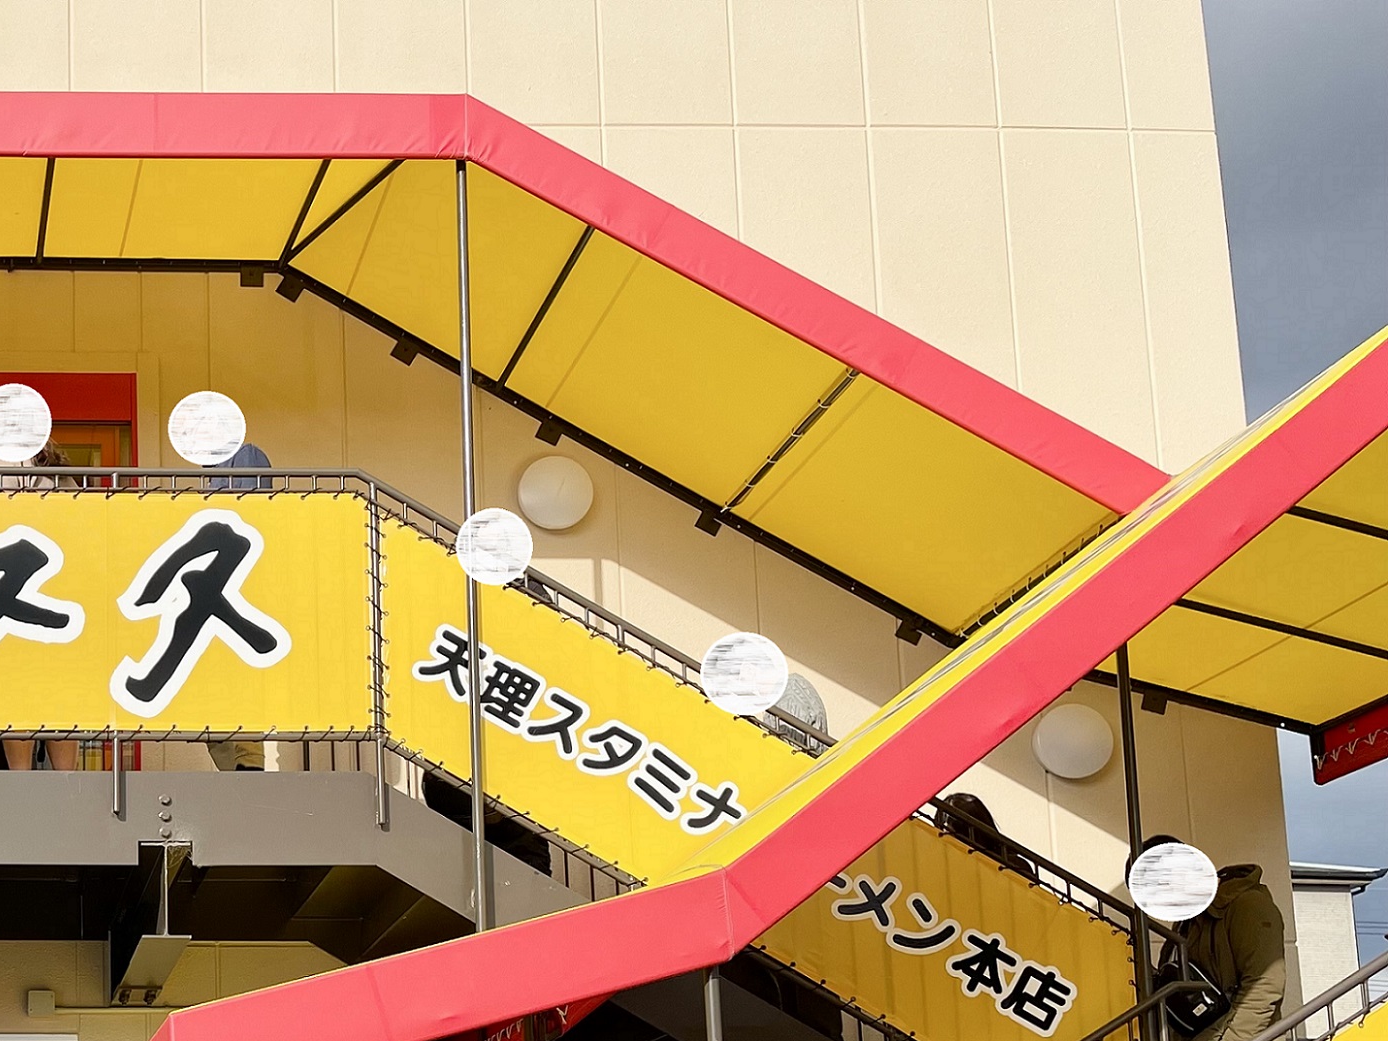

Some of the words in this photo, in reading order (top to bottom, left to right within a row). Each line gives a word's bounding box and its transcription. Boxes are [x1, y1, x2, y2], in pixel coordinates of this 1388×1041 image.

[415, 627, 744, 832] 天理スタミナ
